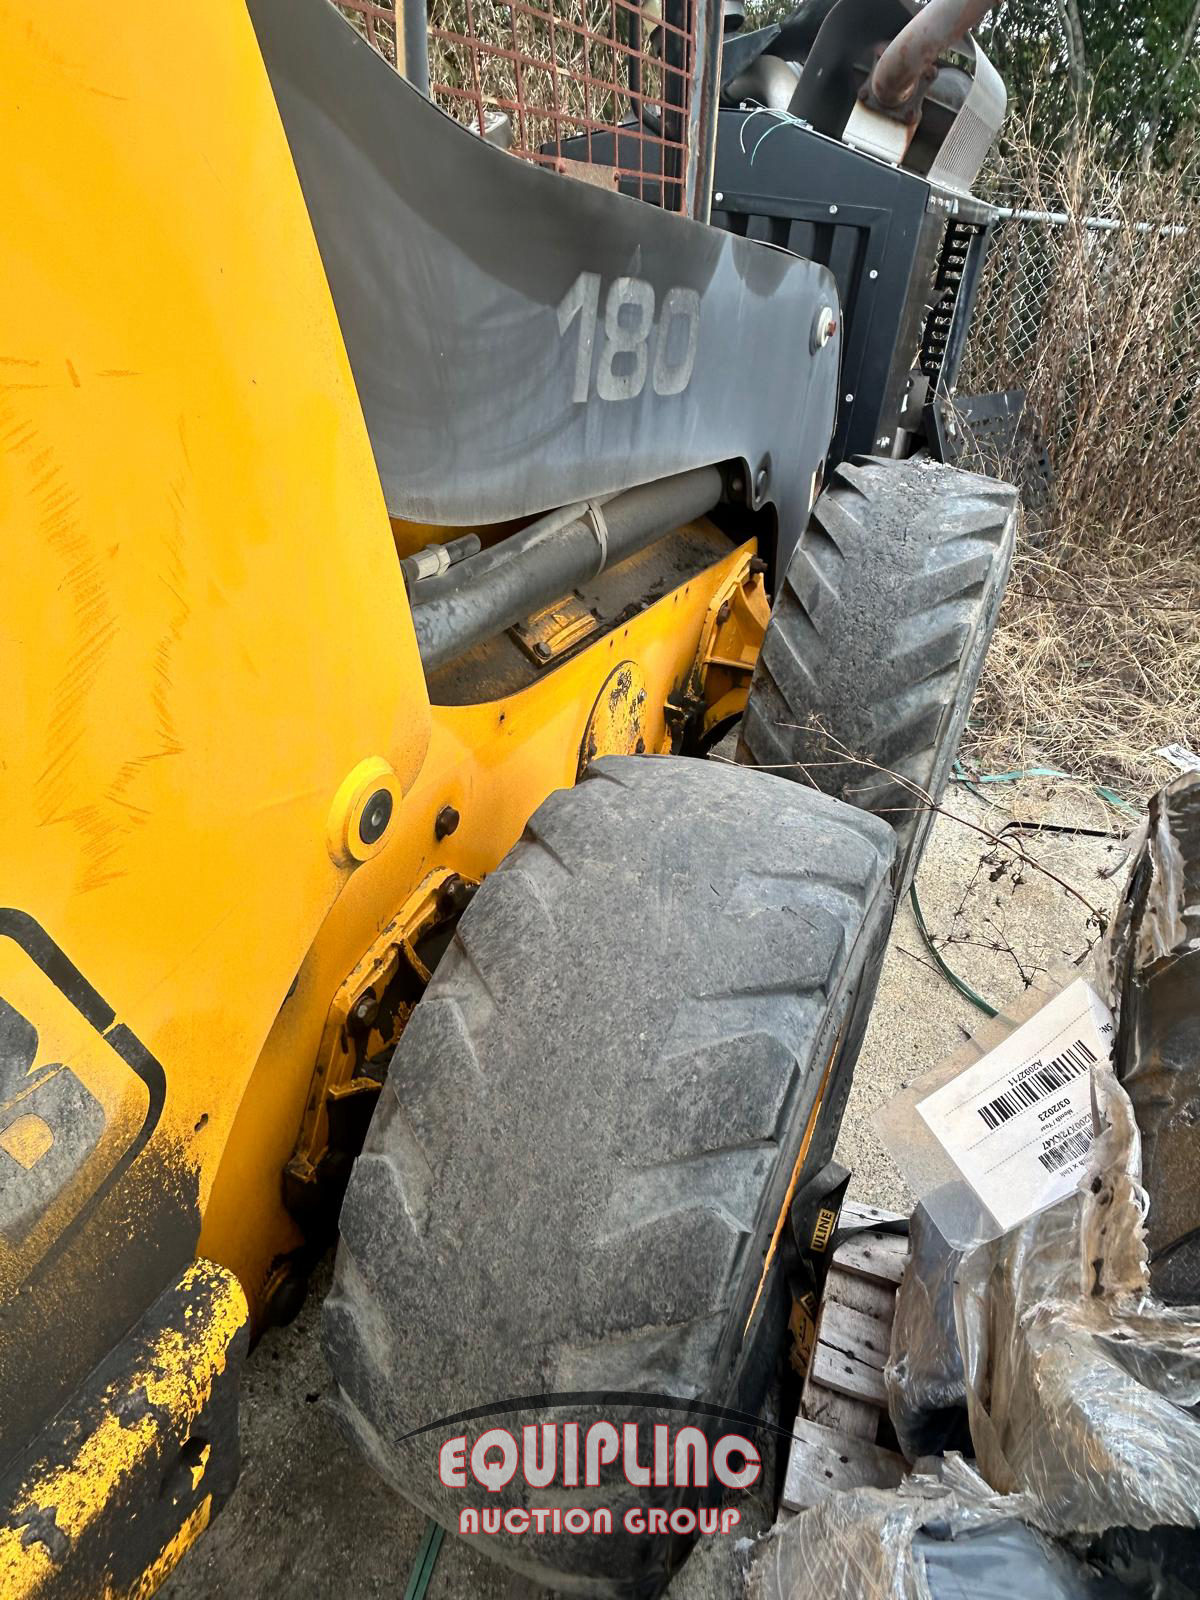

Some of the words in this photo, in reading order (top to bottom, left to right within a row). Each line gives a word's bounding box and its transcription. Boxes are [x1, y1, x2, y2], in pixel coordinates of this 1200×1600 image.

[557, 272, 701, 403] 180
[1037, 1098, 1071, 1122] 03/2023
[813, 1211, 832, 1249] ULINE
